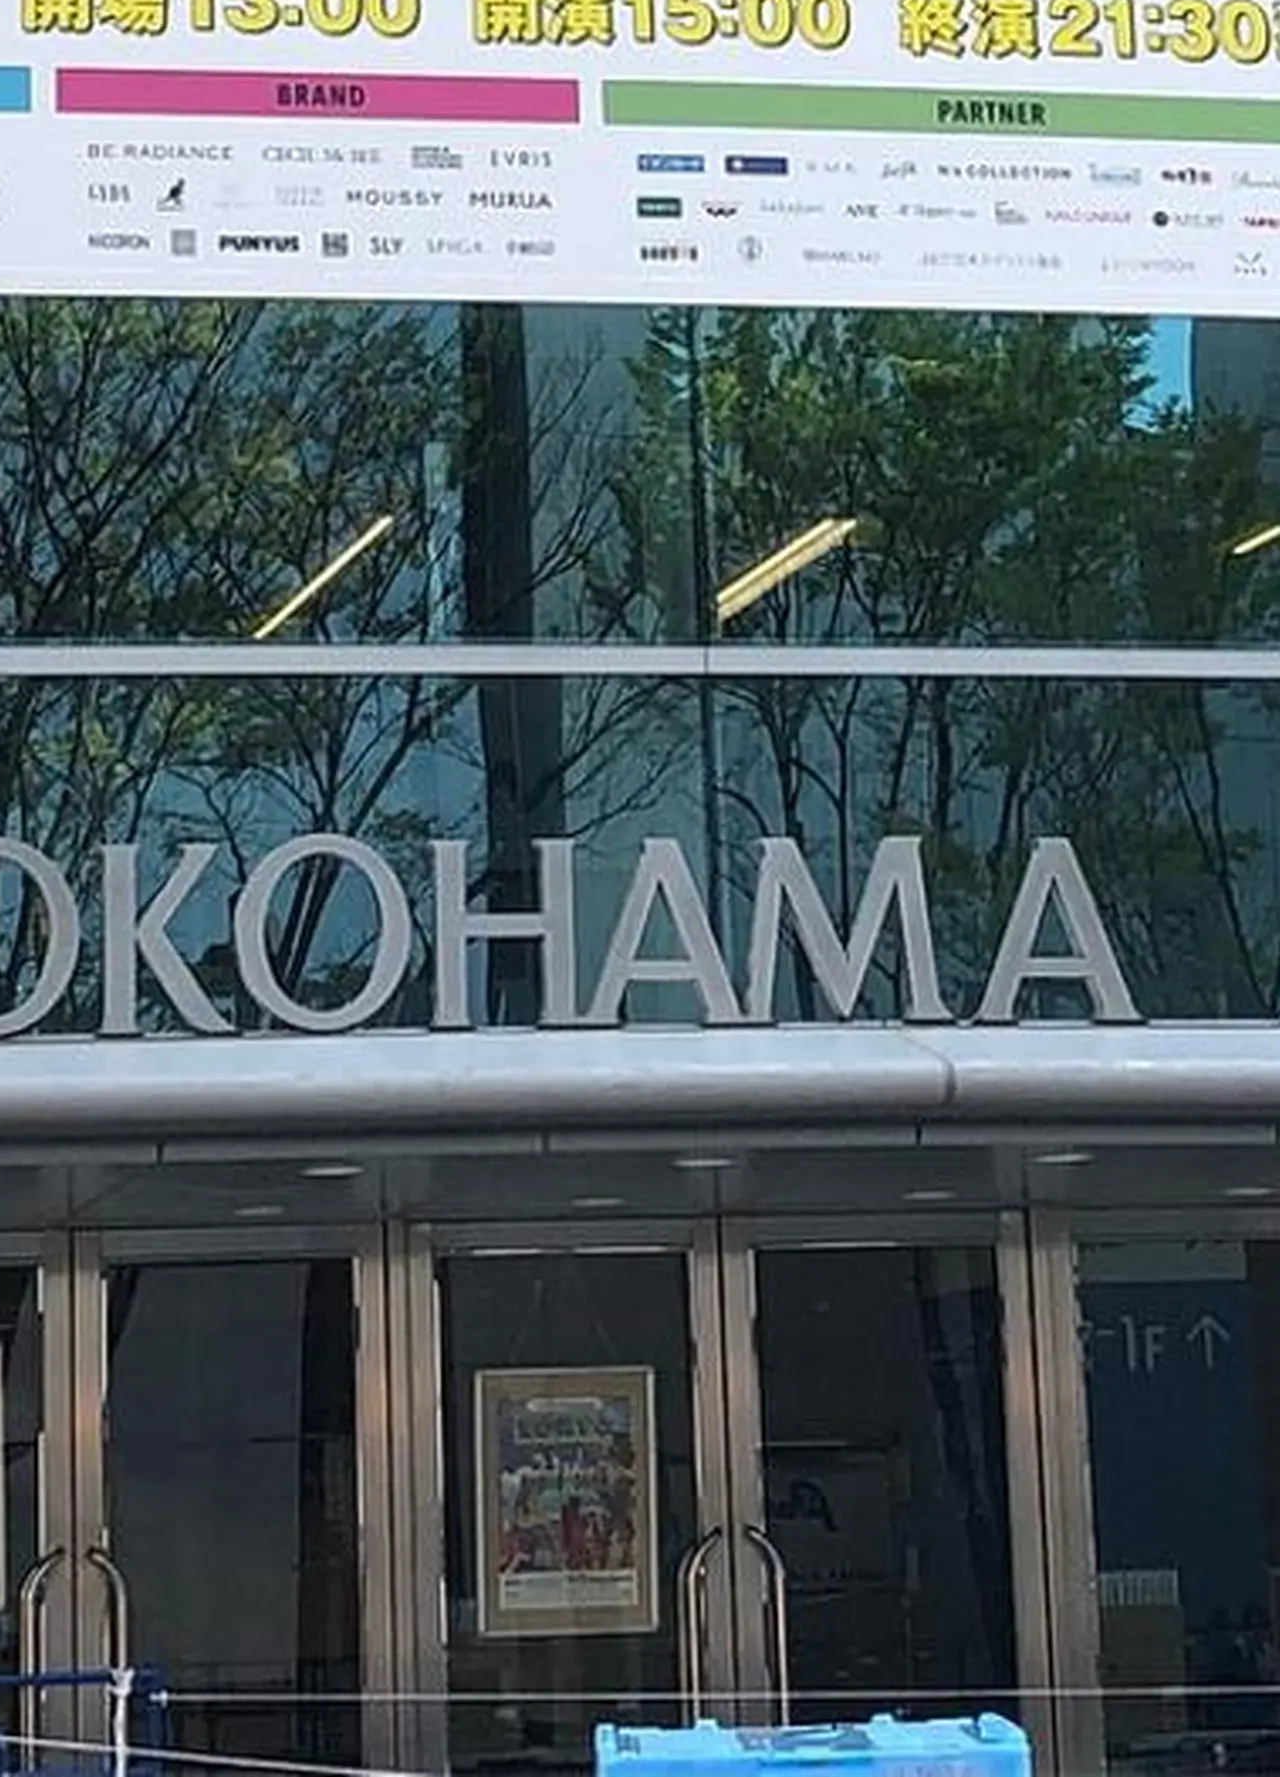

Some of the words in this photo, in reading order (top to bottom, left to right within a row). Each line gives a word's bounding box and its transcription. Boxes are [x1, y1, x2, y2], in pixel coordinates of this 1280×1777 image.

[275, 83, 367, 110] BRAND
[936, 98, 1048, 127] PARTNER
[122, 144, 235, 161] RADIANCE
[345, 188, 444, 207] MOUSSY
[469, 192, 554, 210] MURUA
[220, 234, 301, 253] PUNYUS
[368, 235, 405, 256] SLY
